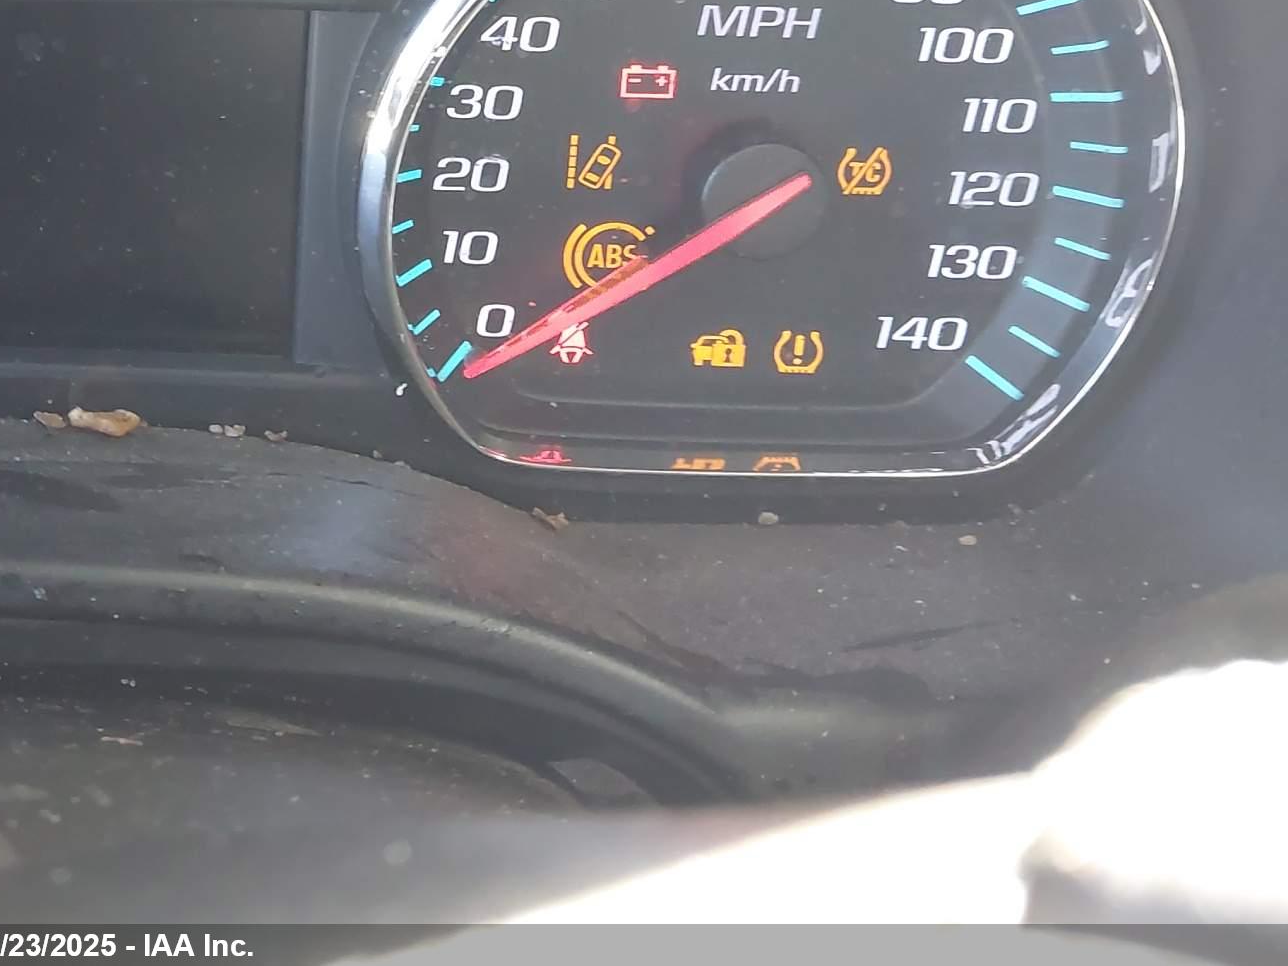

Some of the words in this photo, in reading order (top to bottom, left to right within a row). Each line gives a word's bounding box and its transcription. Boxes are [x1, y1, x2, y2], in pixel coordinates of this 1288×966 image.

[480, 16, 560, 52] 40
[697, 4, 822, 39] MPH
[918, 27, 1015, 64] 100
[710, 67, 801, 93] km/h
[446, 84, 523, 120] 30
[962, 97, 1038, 134] 110
[432, 156, 510, 192] 20
[948, 171, 1040, 207] 120
[442, 230, 499, 265] 10
[587, 243, 638, 269] ABS
[927, 244, 1017, 280] 130
[476, 303, 514, 338] 0
[876, 316, 967, 351] 140
